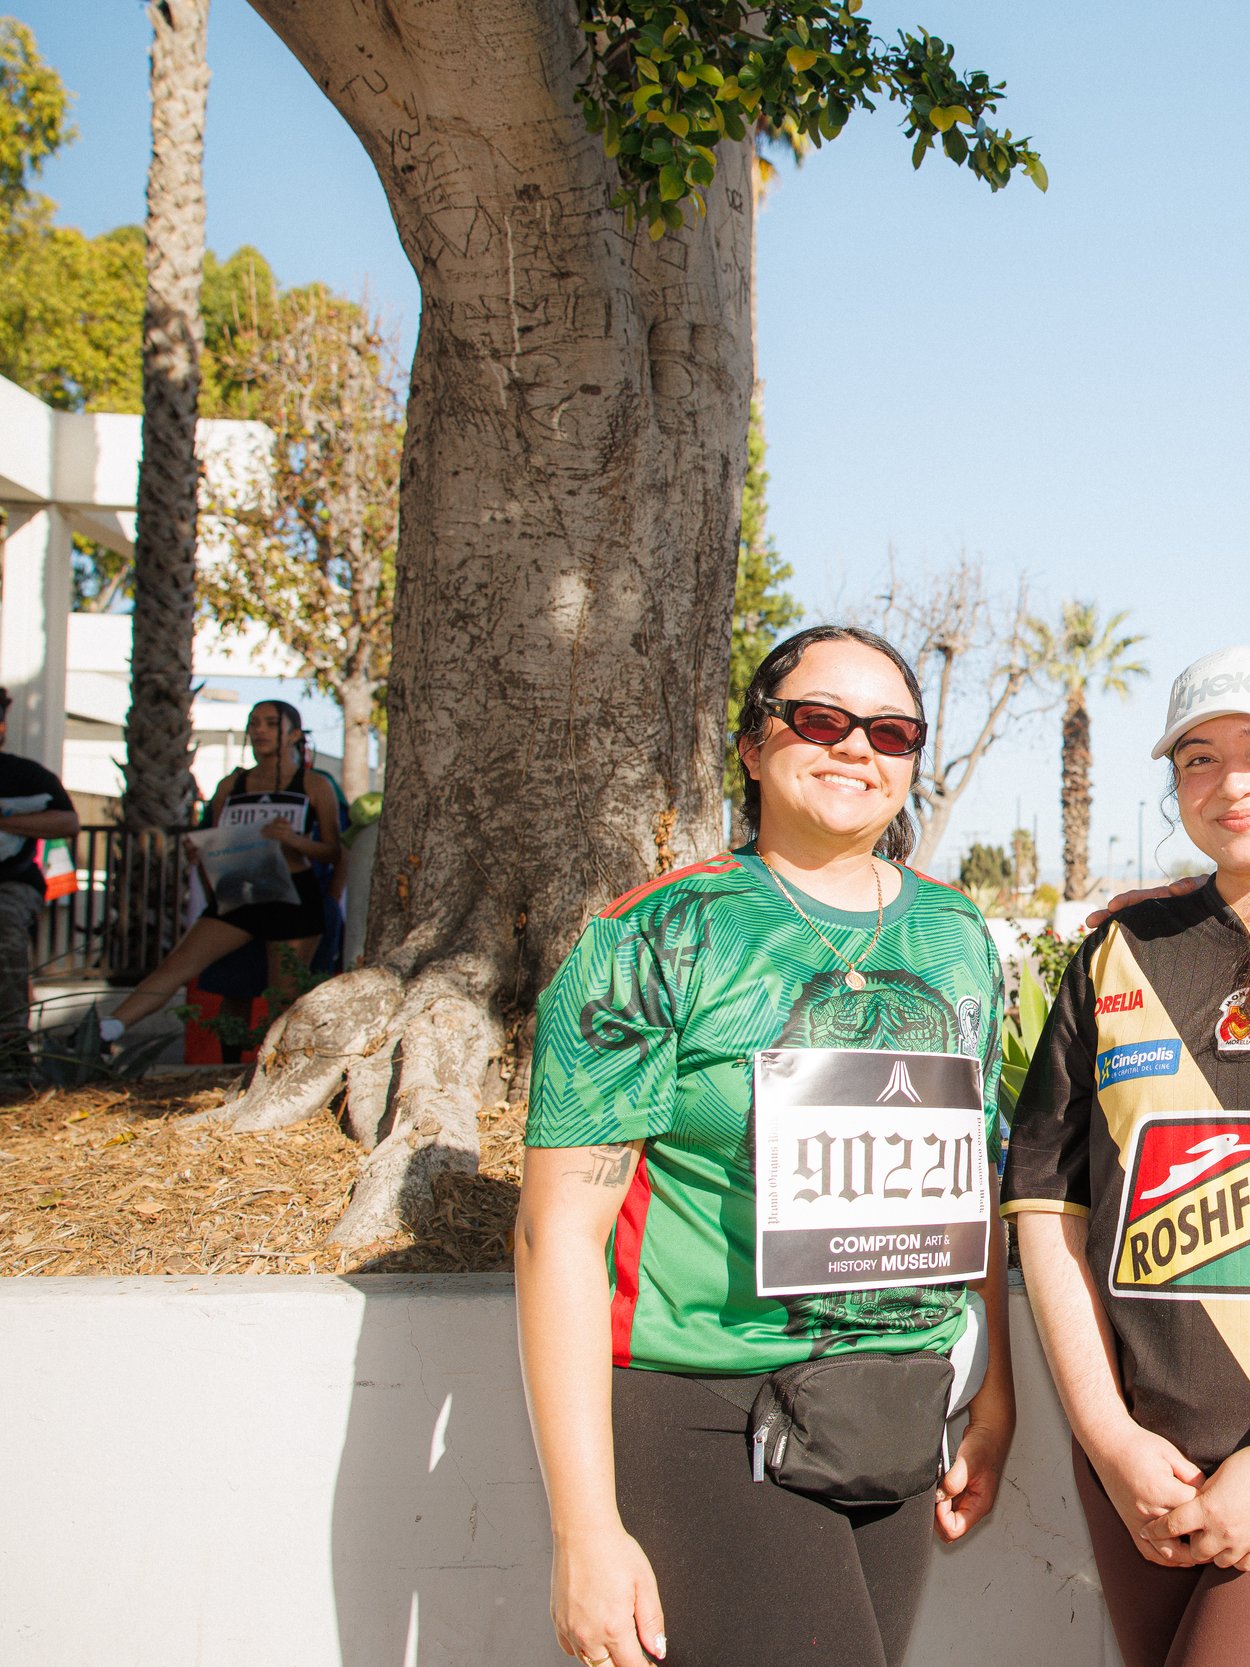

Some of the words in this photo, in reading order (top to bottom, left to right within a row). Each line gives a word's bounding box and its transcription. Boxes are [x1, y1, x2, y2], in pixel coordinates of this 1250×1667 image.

[1094, 989, 1144, 1018] ORELIA
[1111, 1046, 1175, 1070] Cinépolis
[1154, 1062, 1170, 1070] CINE
[792, 1130, 973, 1204] 90220
[829, 1234, 921, 1254] COMPTON
[925, 1235, 943, 1246] ART
[943, 1235, 950, 1245] &
[828, 1260, 877, 1273] HISTORY
[881, 1252, 951, 1271] MUSEUM
